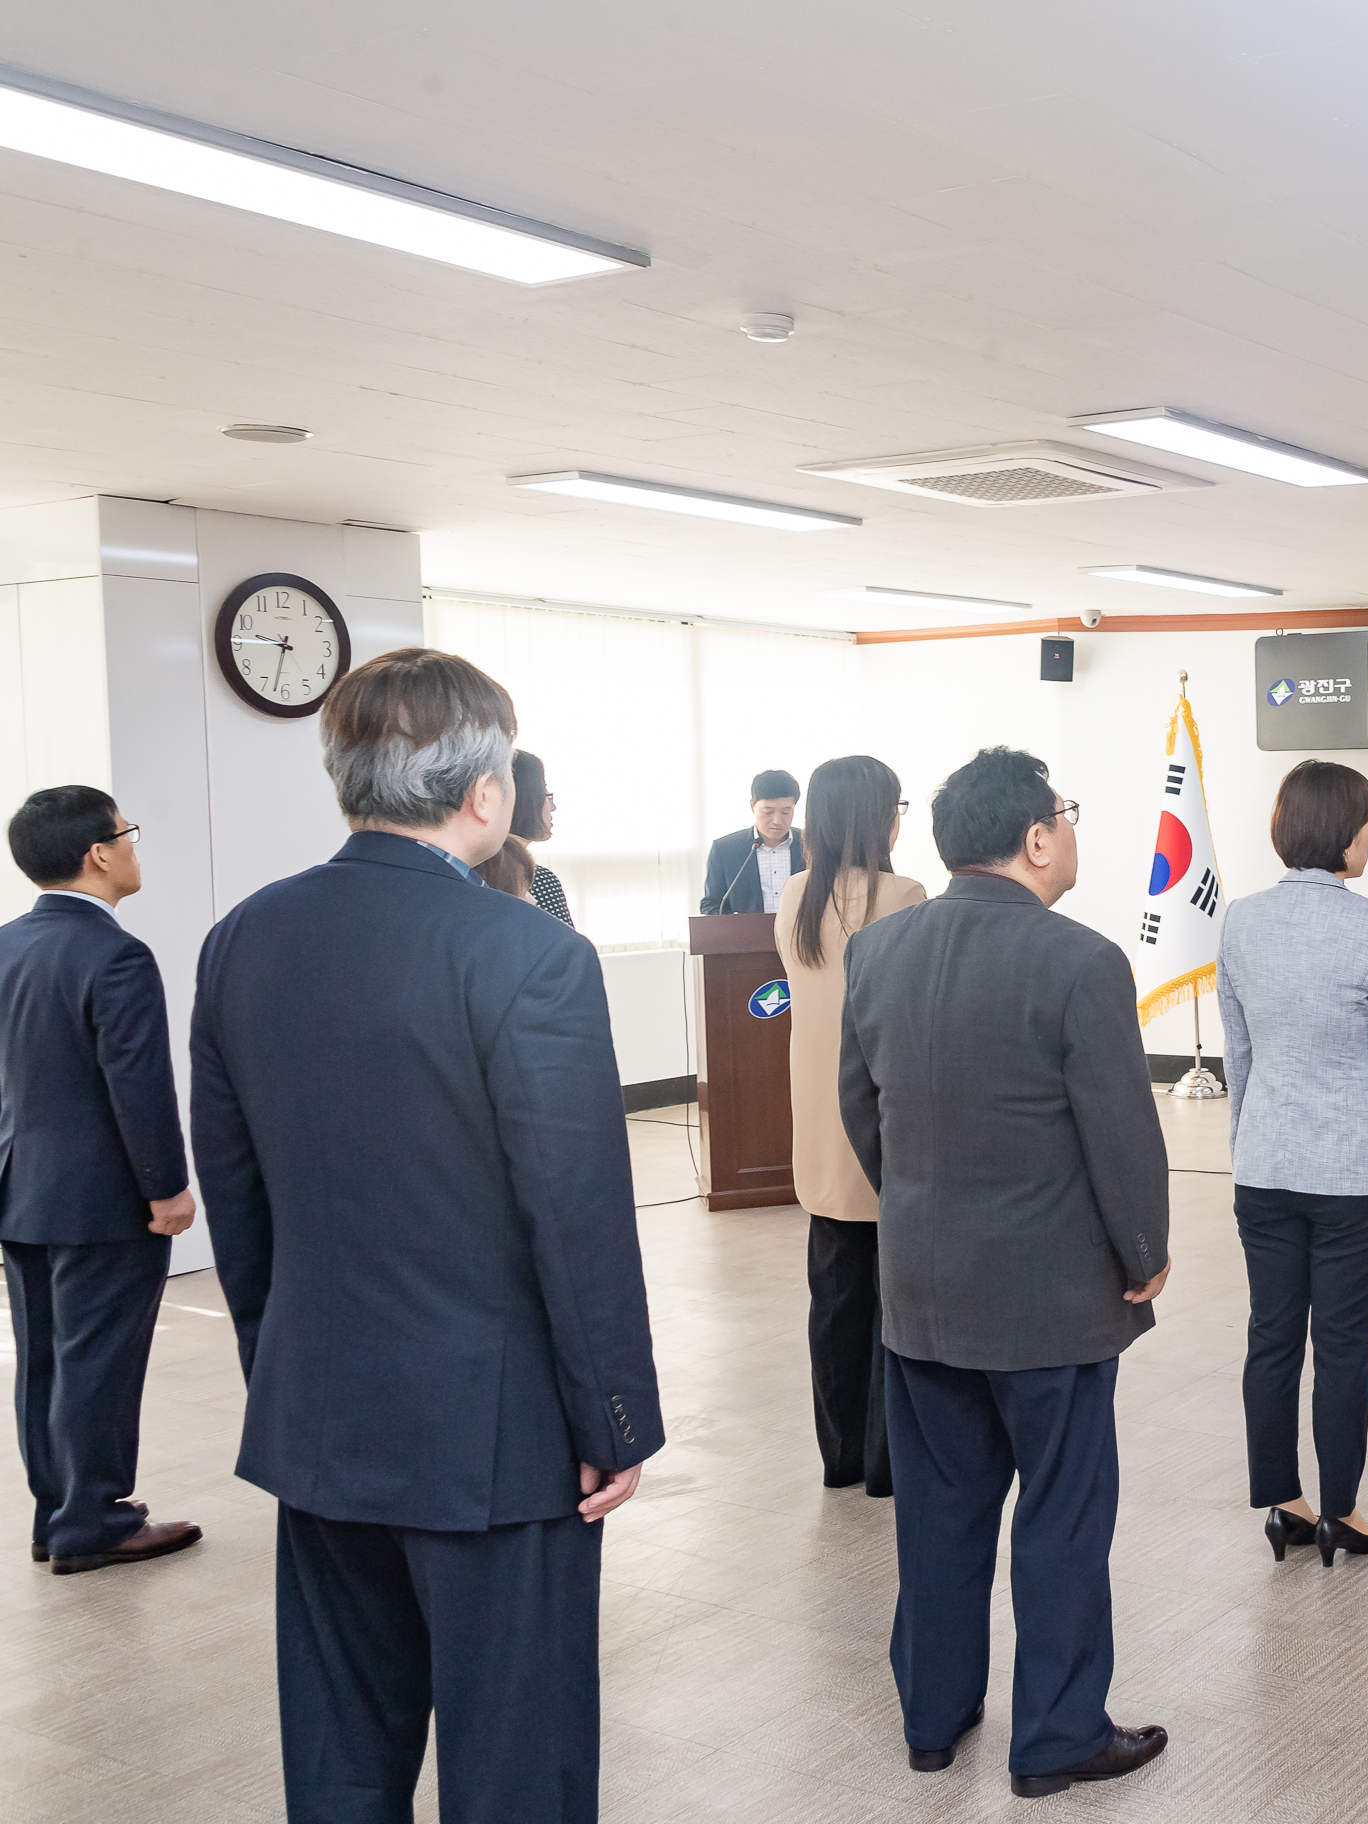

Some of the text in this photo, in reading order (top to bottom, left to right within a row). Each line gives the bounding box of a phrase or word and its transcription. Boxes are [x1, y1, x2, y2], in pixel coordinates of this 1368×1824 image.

[256, 595, 268, 612] 11
[275, 591, 291, 609] 12
[302, 599, 307, 616] 1
[239, 614, 253, 631] 10
[314, 615, 324, 633] 2
[232, 635, 243, 652] 9
[322, 640, 332, 658] 3
[242, 658, 252, 676] 8
[316, 663, 326, 680] 4
[260, 676, 269, 692] 7
[280, 683, 290, 700] 6
[302, 679, 311, 696] 5
[1298, 678, 1352, 695] 광진구
[1299, 695, 1351, 704] GWANGJIN-GU
